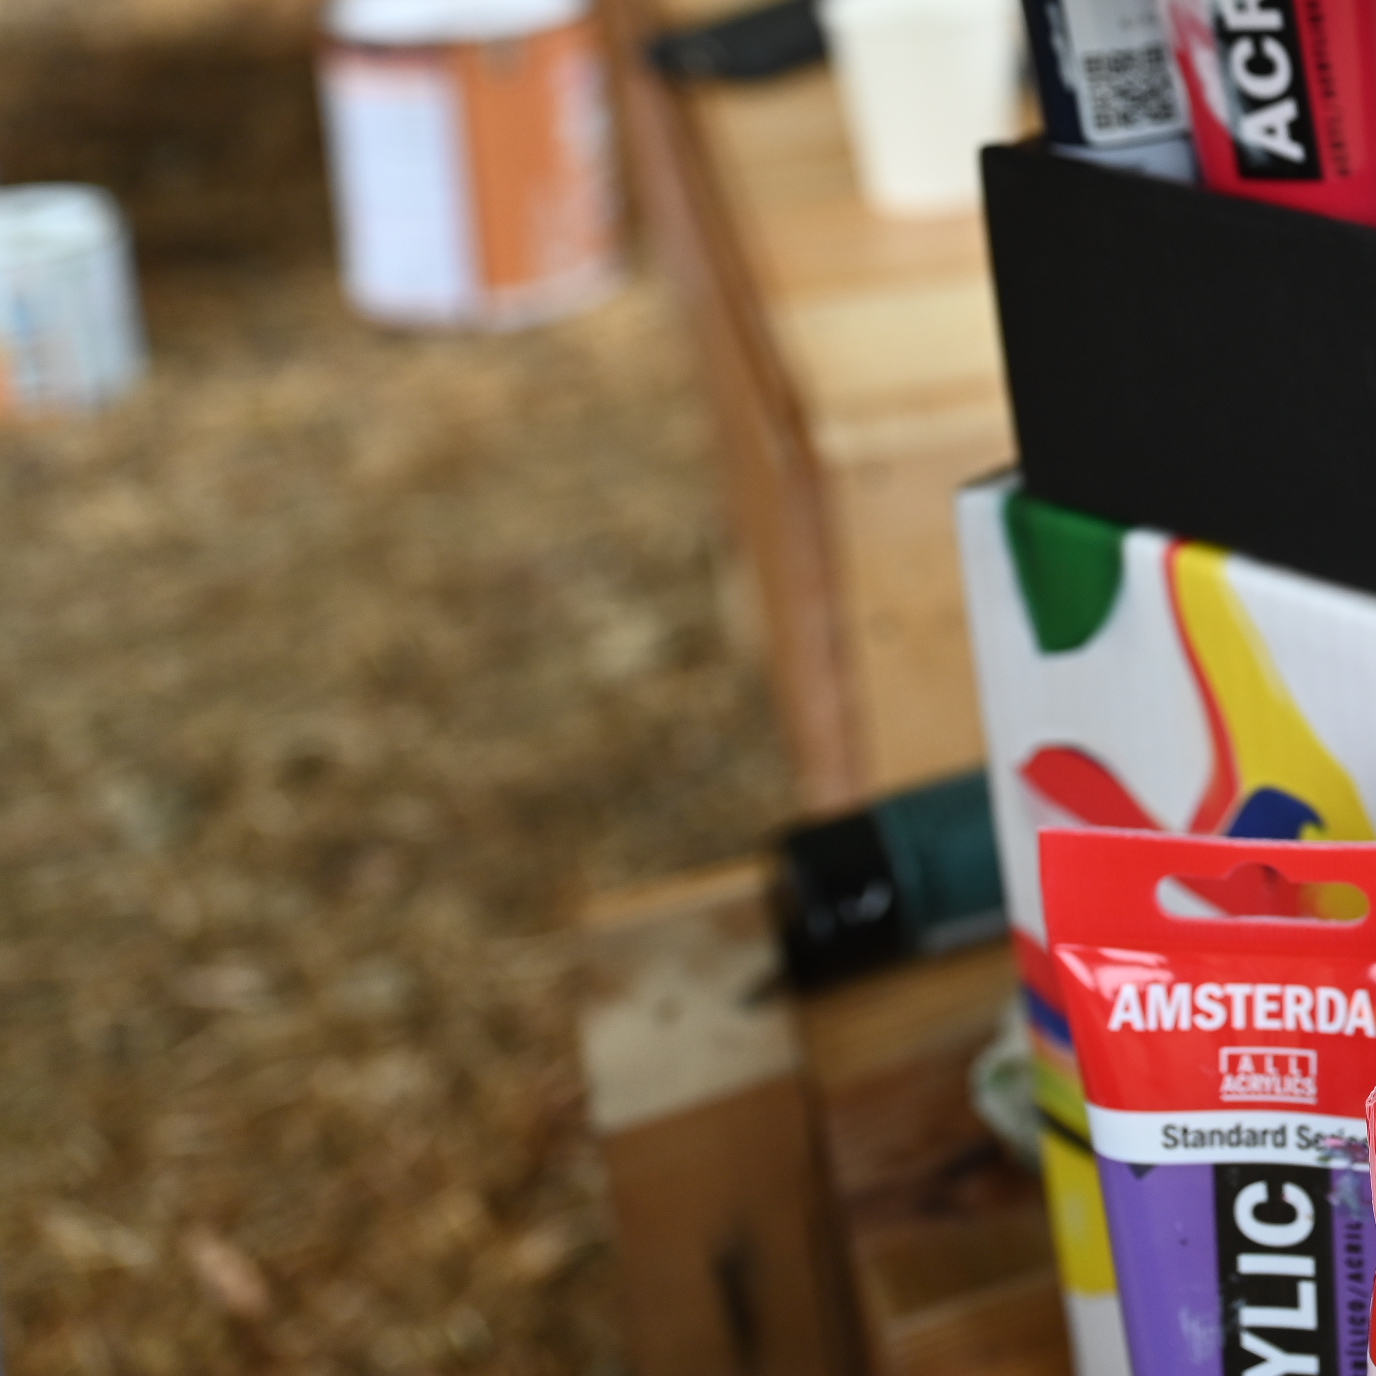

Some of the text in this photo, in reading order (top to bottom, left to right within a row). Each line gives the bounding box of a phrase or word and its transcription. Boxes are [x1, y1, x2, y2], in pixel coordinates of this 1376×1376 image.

[1235, 1054, 1304, 1076] ALL
[1219, 1074, 1318, 1098] ACRYLICS
[1161, 1125, 1288, 1151] Standard
[1232, 1180, 1320, 1376] YLIC
